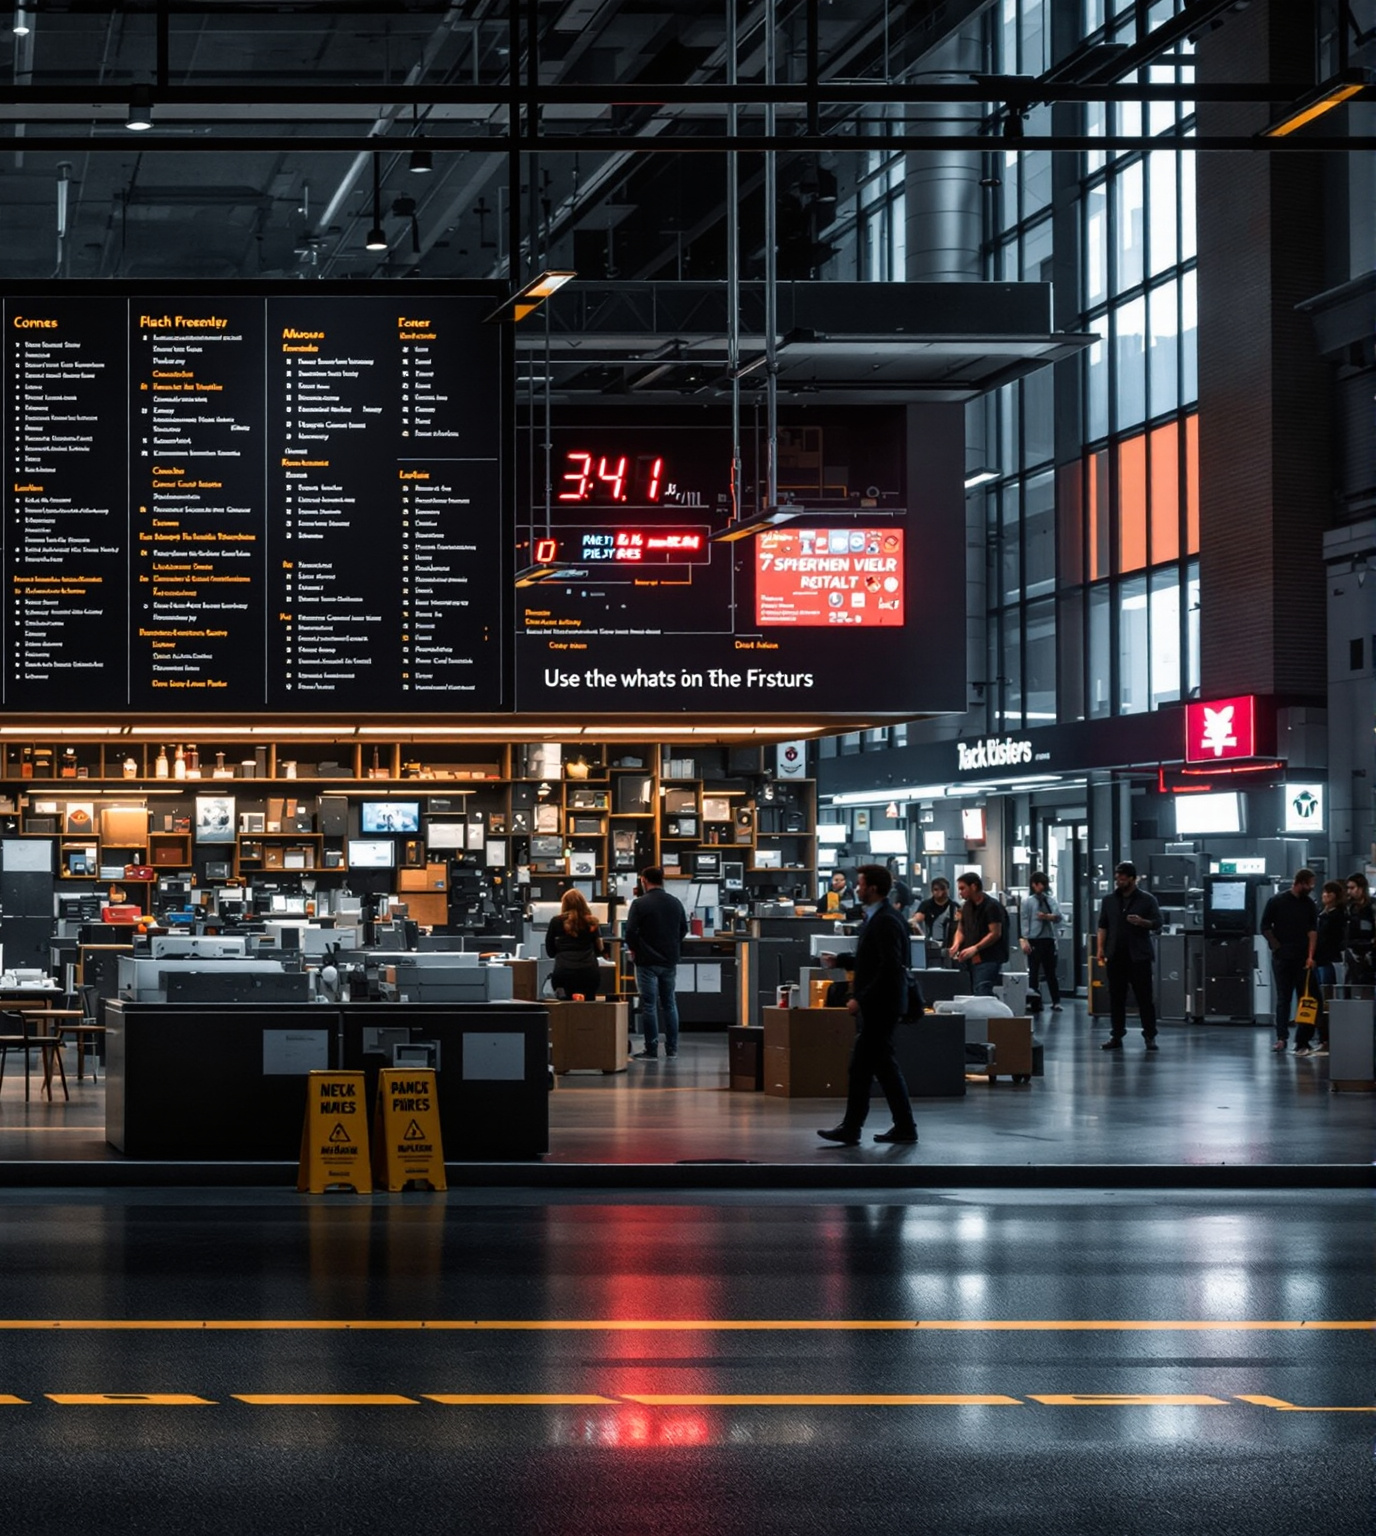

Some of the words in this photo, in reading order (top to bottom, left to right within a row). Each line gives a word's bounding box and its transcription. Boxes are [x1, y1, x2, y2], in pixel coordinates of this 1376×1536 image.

[545, 669, 580, 687] Use
[585, 669, 617, 687] the
[621, 669, 676, 687] whats
